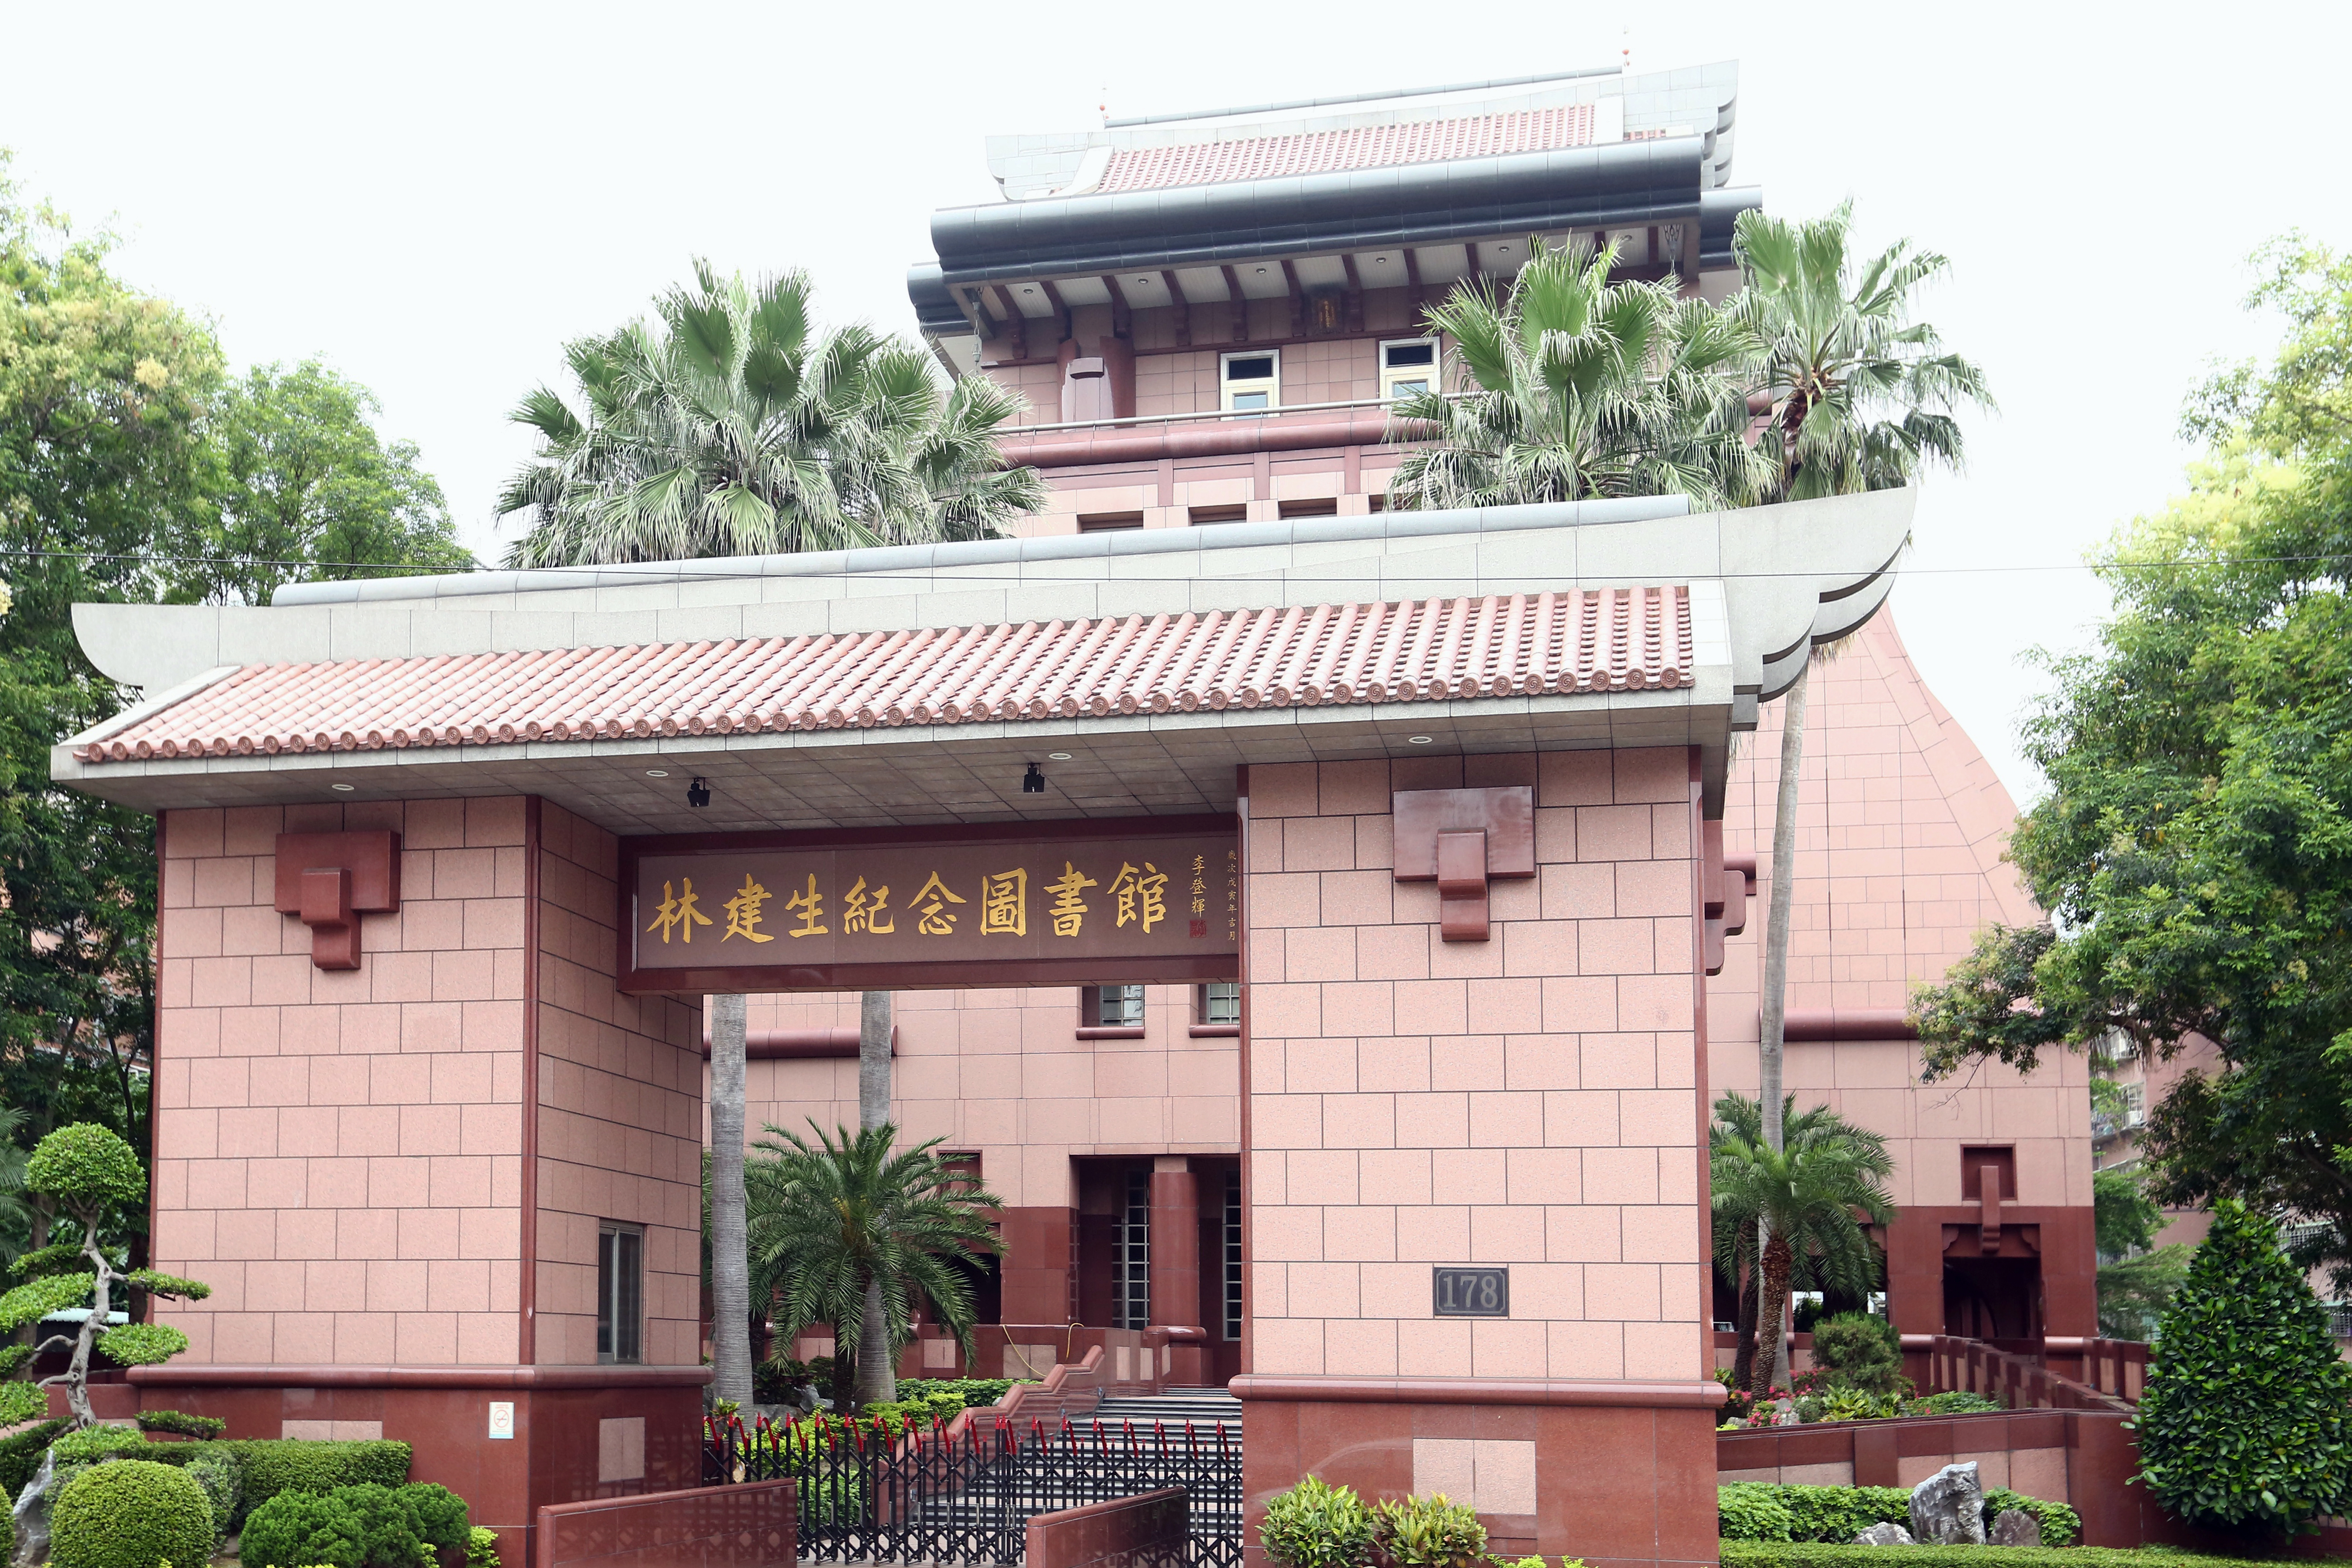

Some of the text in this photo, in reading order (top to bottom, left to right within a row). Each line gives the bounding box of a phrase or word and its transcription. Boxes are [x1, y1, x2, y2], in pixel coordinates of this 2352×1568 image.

[646, 861, 1169, 944] 林建生紀念圖書館
[1189, 854, 1207, 918] 李登輝
[1443, 1275, 1498, 1308] 178
